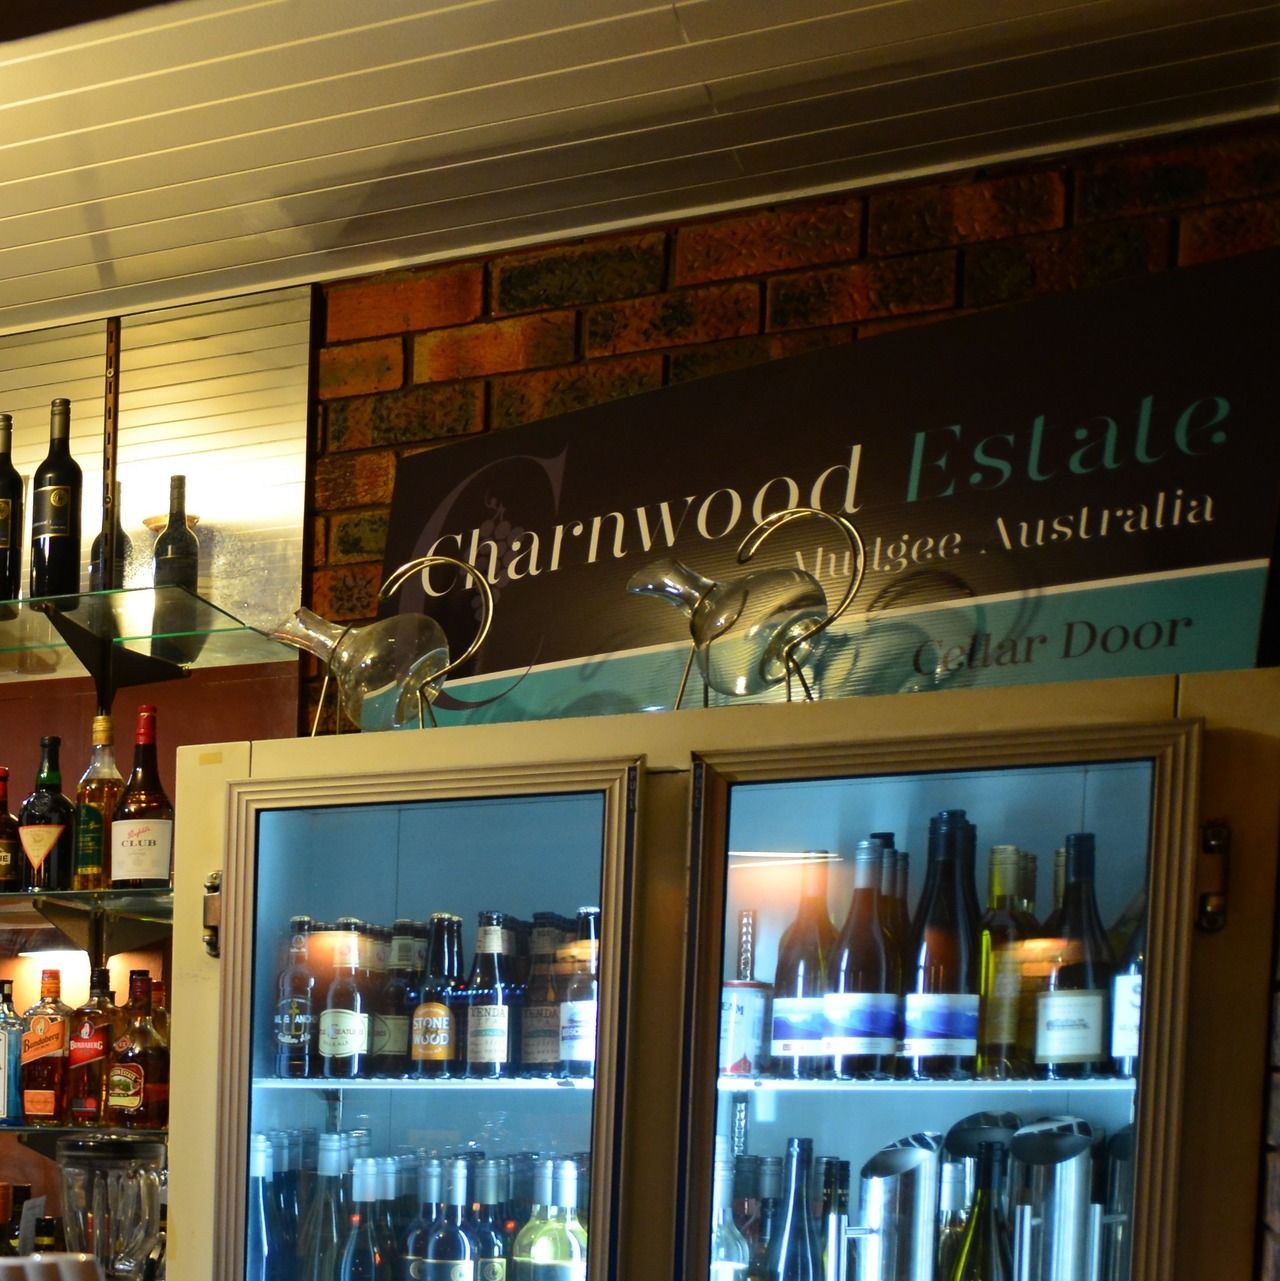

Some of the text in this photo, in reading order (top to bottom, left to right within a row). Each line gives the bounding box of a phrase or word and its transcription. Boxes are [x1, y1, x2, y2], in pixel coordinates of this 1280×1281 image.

[419, 395, 1232, 598] Charnwood Estate
[980, 488, 1215, 555] Australia
[913, 616, 1193, 677] Cellar Door
[121, 839, 157, 847] CLUB
[412, 1017, 449, 1029] STONE
[70, 1041, 103, 1050] BUNDABERG
[413, 1033, 449, 1046] WOOD
